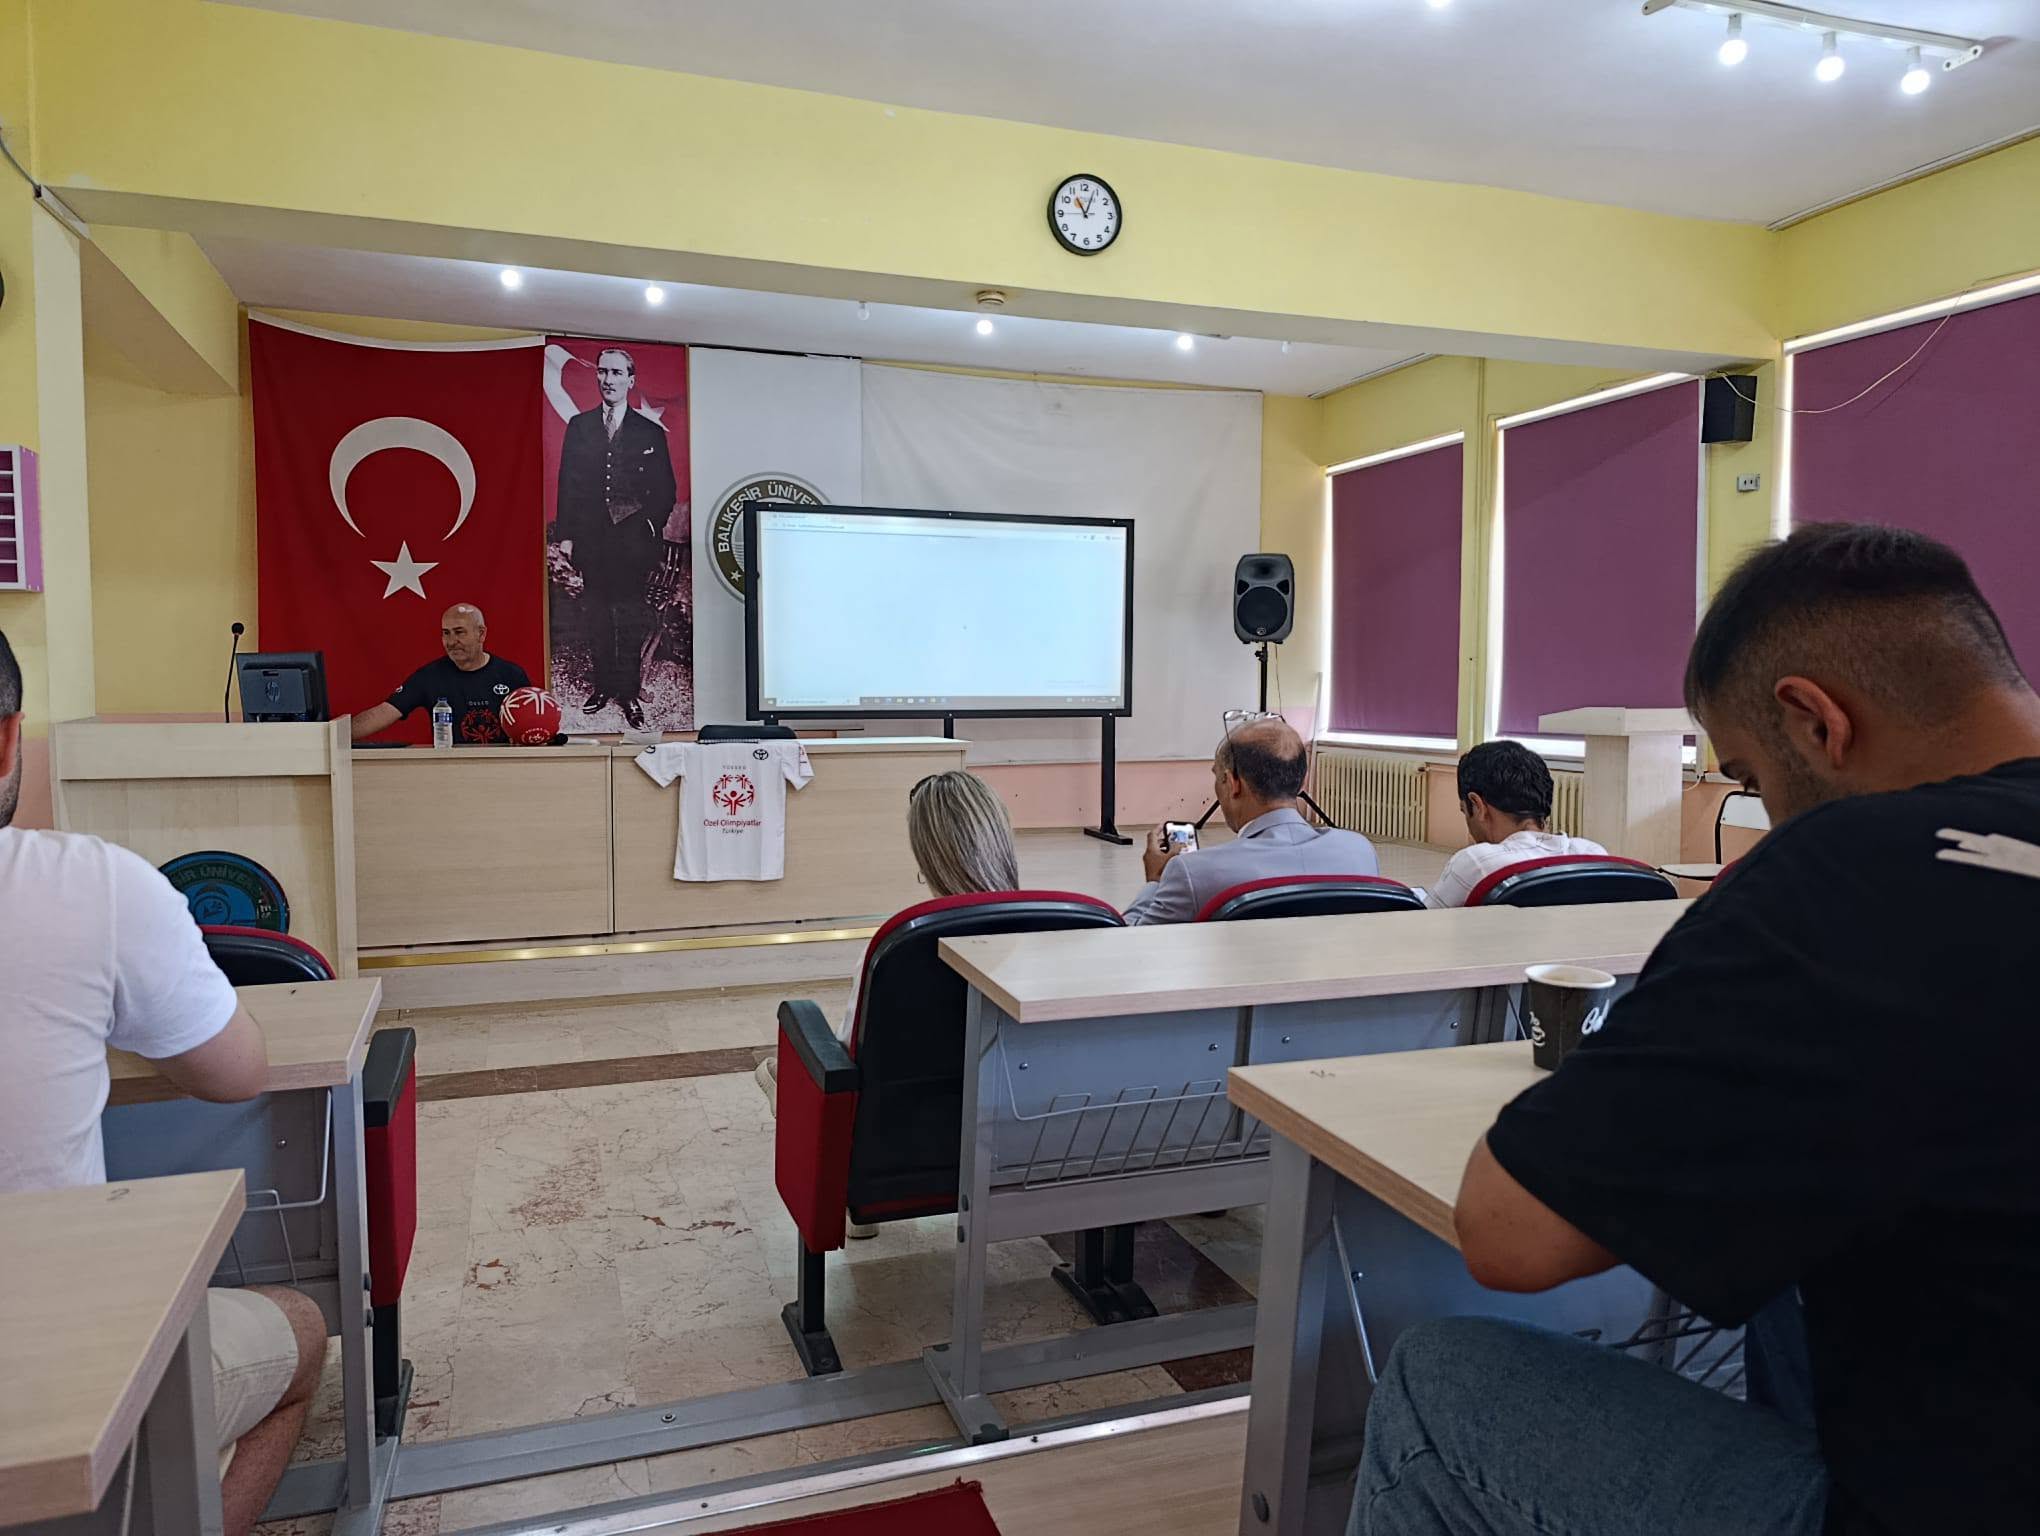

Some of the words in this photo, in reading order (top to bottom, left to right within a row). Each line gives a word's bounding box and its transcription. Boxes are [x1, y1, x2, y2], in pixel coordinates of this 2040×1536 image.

[1069, 186, 1076, 195] 11
[1080, 183, 1089, 192] 12
[1061, 195, 1071, 204] 10
[1102, 197, 1109, 206] 2
[1057, 209, 1065, 218] 9
[1107, 212, 1114, 220] 3
[1061, 223, 1069, 232] 8
[1104, 225, 1110, 233] 4
[1070, 233, 1077, 241] 7
[1083, 237, 1090, 246] 6
[1096, 234, 1103, 243] 5
[767, 481, 817, 506] ÜNİVE
